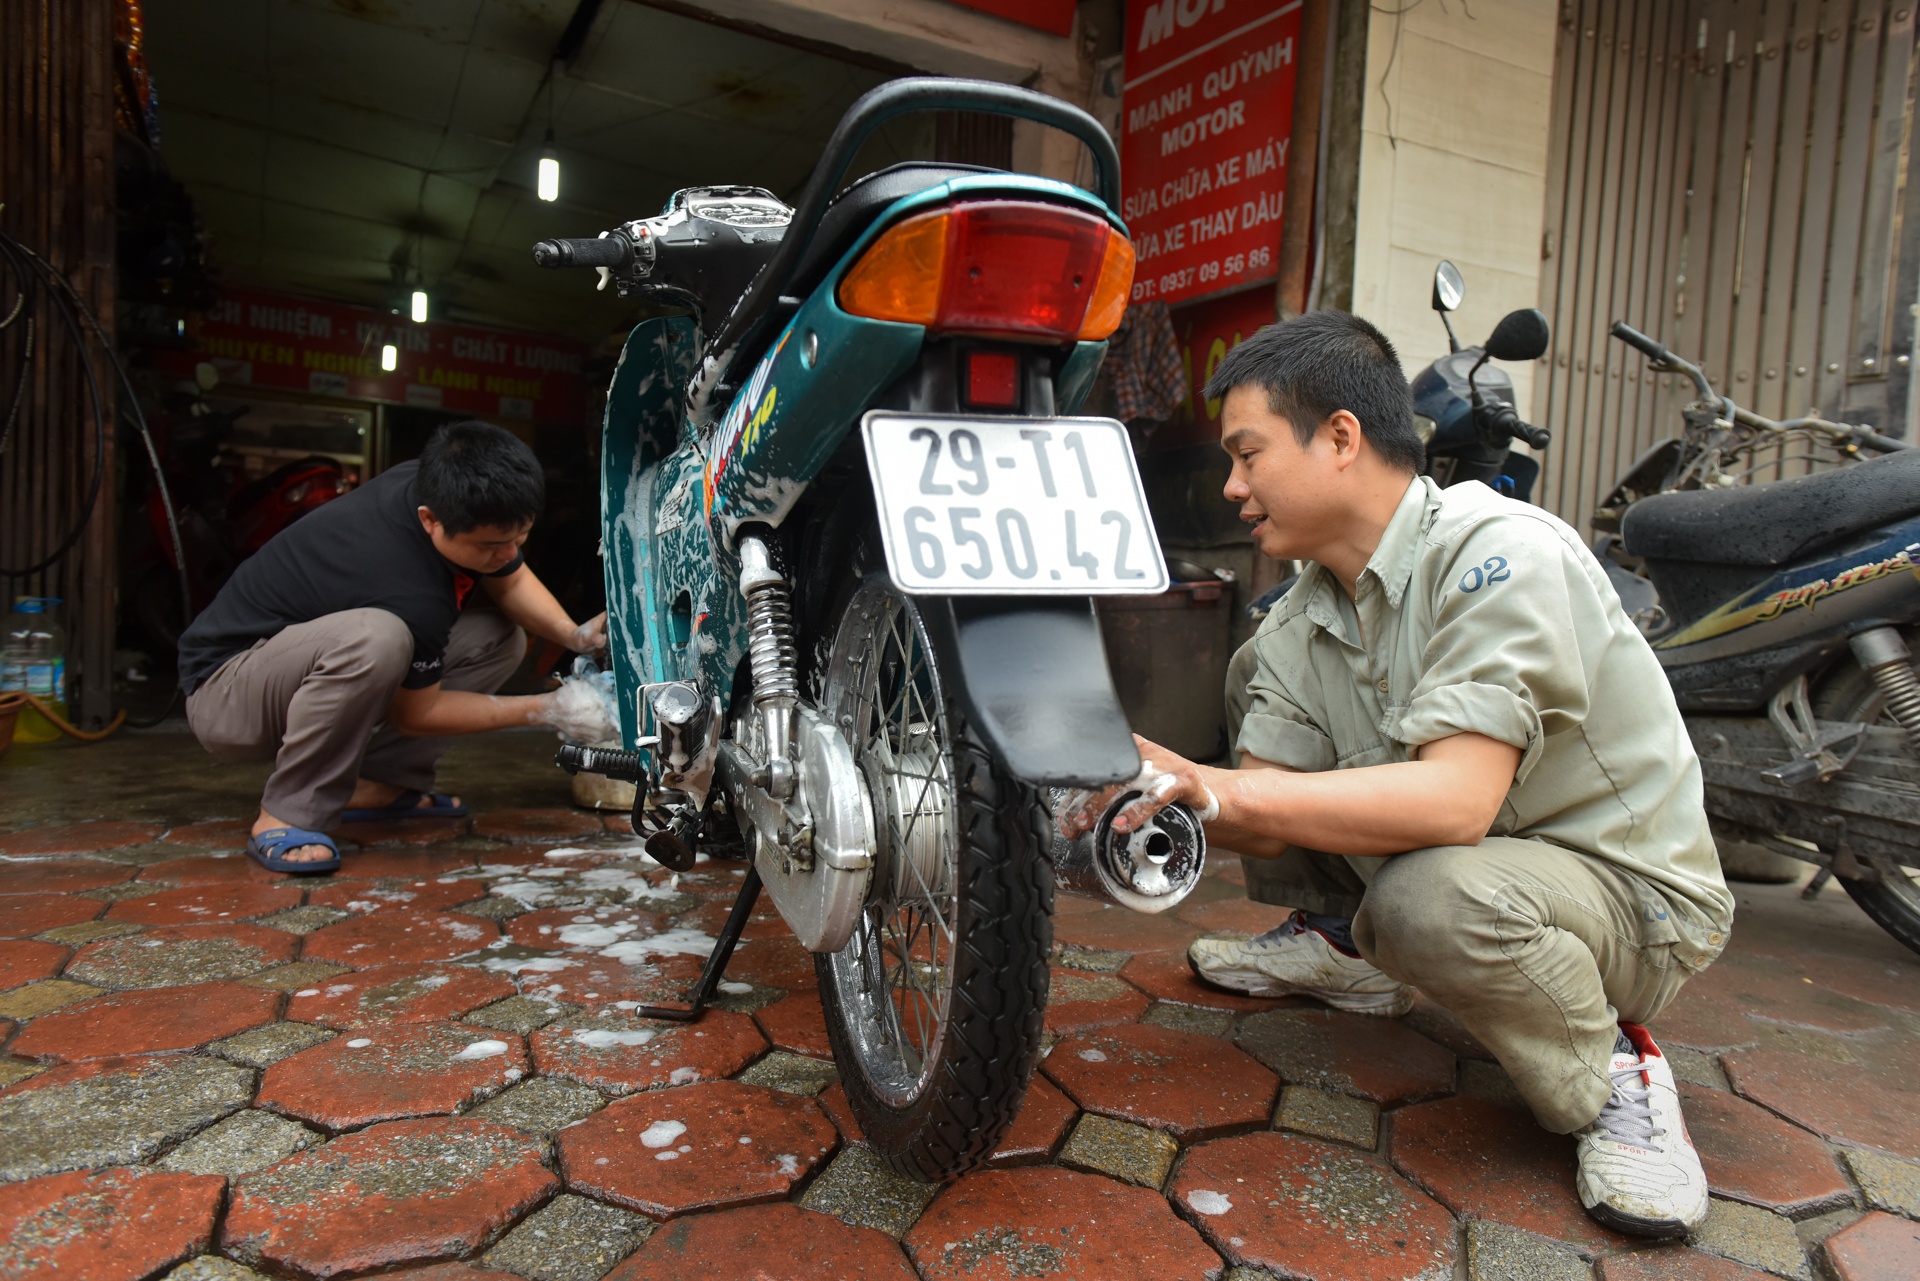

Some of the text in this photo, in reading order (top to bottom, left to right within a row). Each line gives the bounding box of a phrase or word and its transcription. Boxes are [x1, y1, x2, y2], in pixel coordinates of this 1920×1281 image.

[1129, 37, 1293, 134] MẠNH QUỲNH
[1161, 100, 1246, 157] MOTOR
[1161, 167, 1212, 208] CHỮA
[1214, 156, 1242, 189] XE
[1245, 137, 1290, 179] MÁY
[1162, 223, 1187, 255] XE
[1189, 206, 1239, 245] THAY
[1160, 267, 1197, 294] 0937
[1199, 260, 1220, 283] 09
[1223, 253, 1245, 277] 56
[1248, 246, 1270, 269] 86
[741, 386, 777, 459] 110
[909, 427, 1097, 498] 29-T1
[903, 505, 1146, 581] 650.42
[1457, 556, 1511, 593] 02
[1617, 1144, 1648, 1156] SPORT
